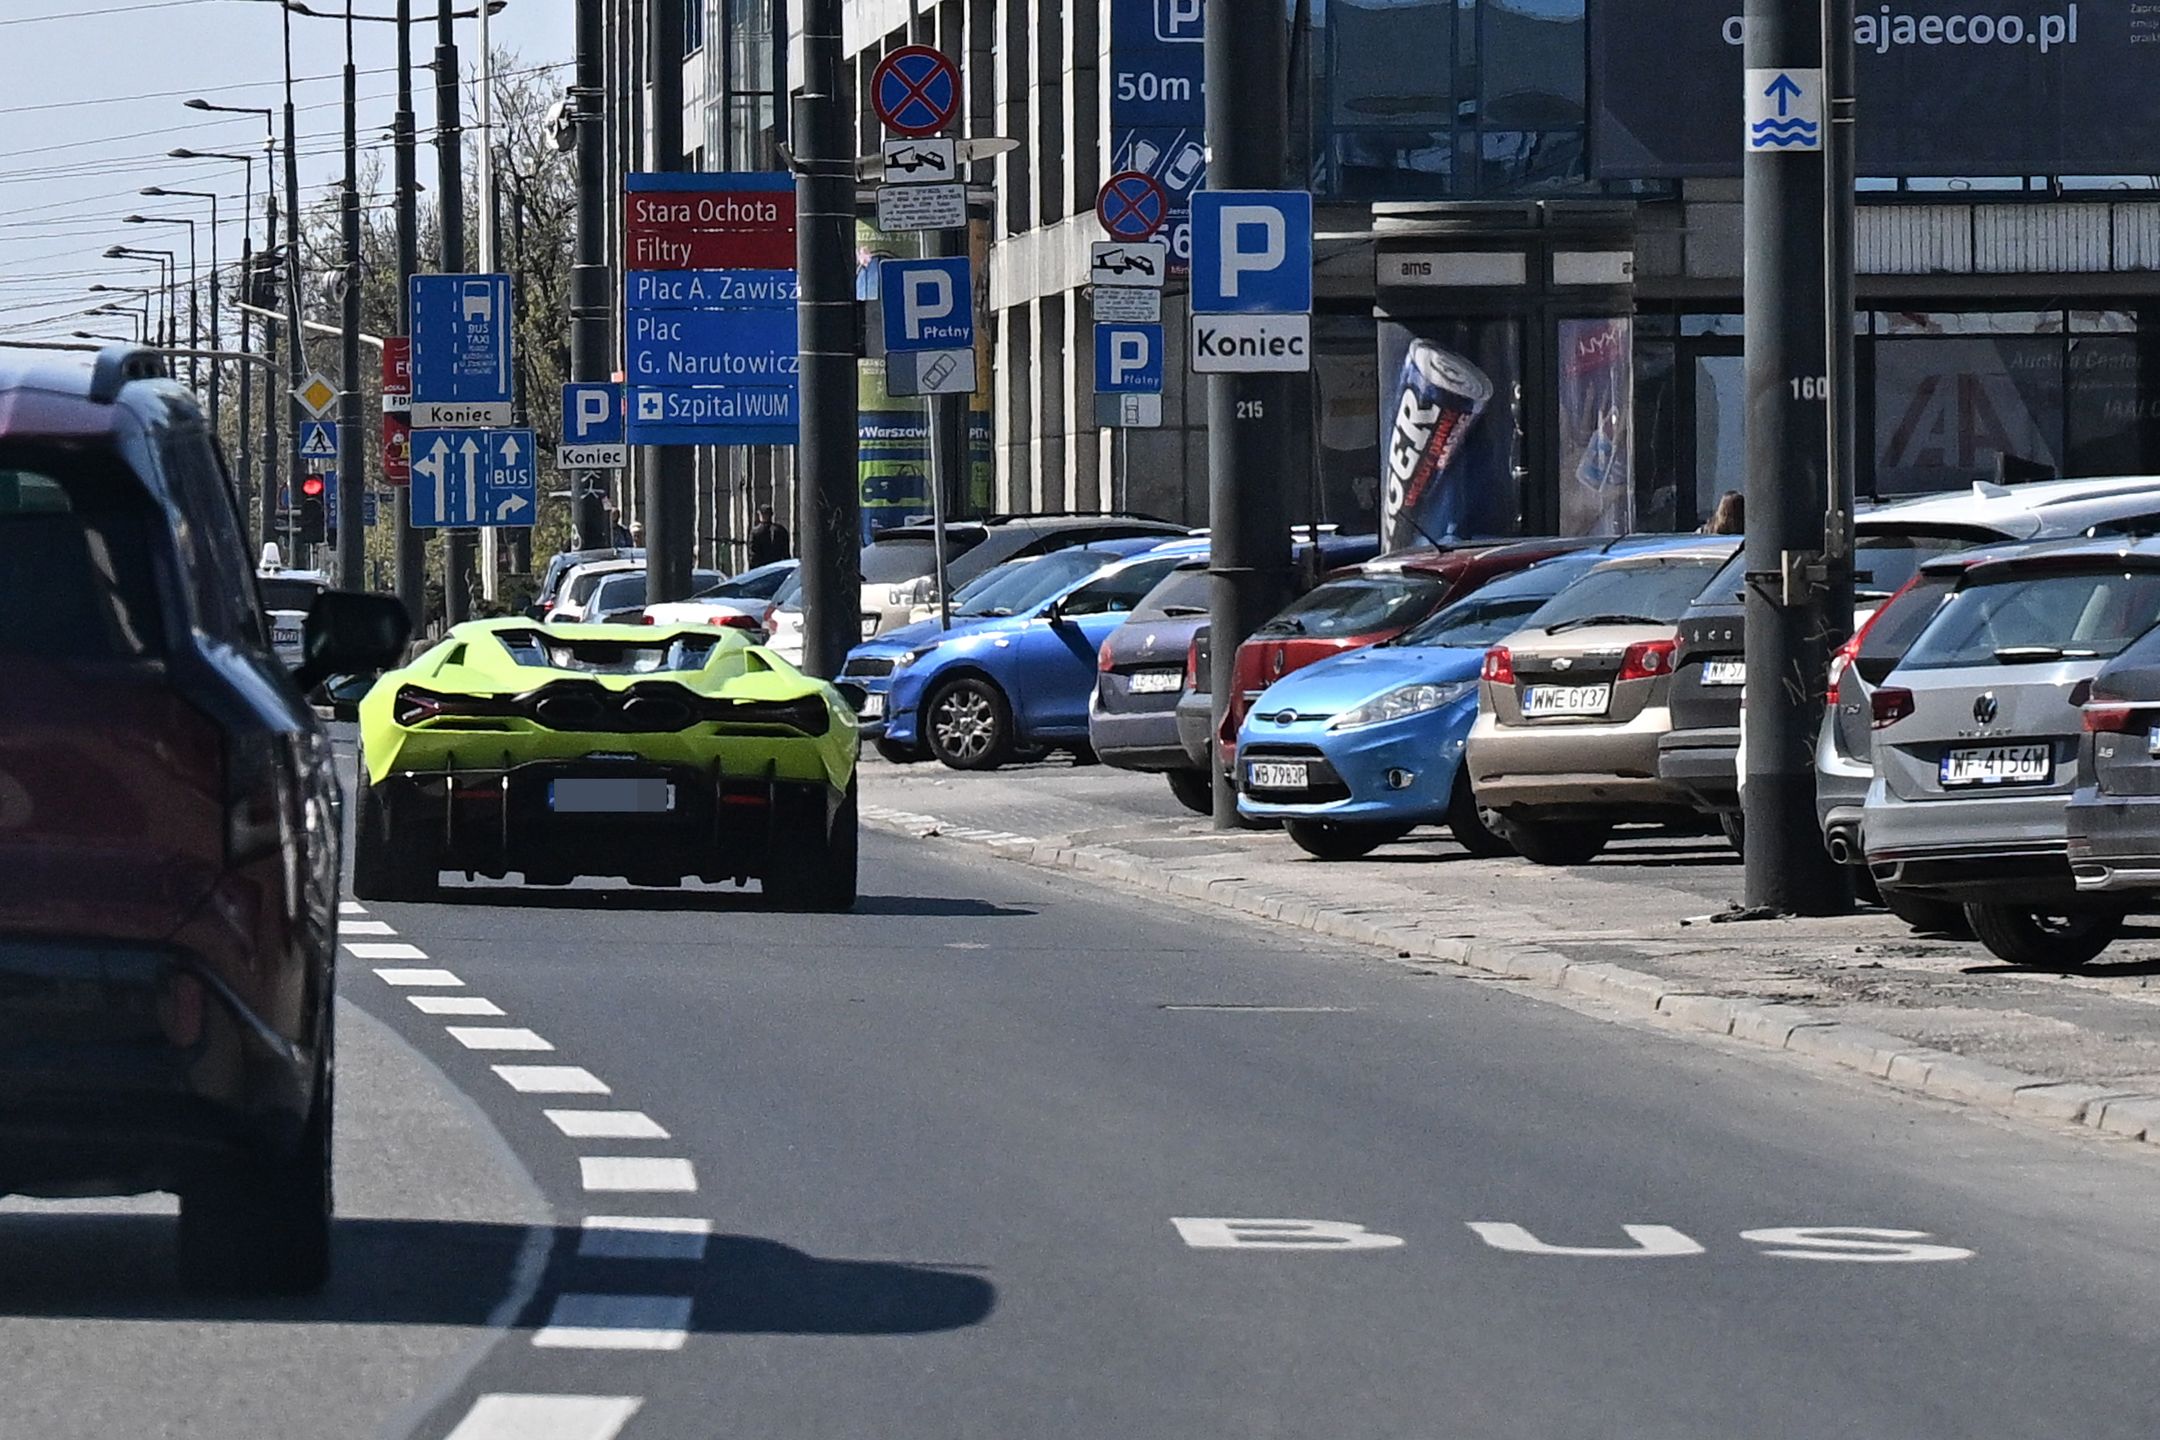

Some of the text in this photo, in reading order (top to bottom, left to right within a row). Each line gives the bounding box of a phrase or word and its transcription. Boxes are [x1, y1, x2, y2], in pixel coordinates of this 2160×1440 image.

[1117, 72, 1190, 101] 50m
[636, 197, 777, 222] Stara Ochota
[636, 237, 692, 266] Filtry
[1220, 205, 1286, 297] P
[1401, 261, 1432, 276] ams
[639, 276, 682, 300] Plac
[689, 277, 712, 300] A.
[903, 269, 954, 339] P
[467, 334, 490, 345] TAXI
[468, 323, 489, 334] BUS
[637, 317, 681, 341] Plac
[923, 325, 970, 341] Płatny
[1197, 328, 1304, 357] Koniec
[638, 351, 660, 374] G.
[1111, 331, 1148, 384] P
[1124, 374, 1160, 388] Płatny
[1790, 376, 1827, 400] 160
[431, 407, 492, 423] Koniec
[577, 390, 609, 436] P
[668, 392, 789, 423] Szpital WUM
[1236, 400, 1264, 418] 215
[562, 450, 621, 465] Koniec
[493, 469, 529, 485] BUS
[1534, 688, 1607, 709] WWE GY37
[1953, 751, 1978, 777] WF
[1169, 1216, 1977, 1263] BUS
